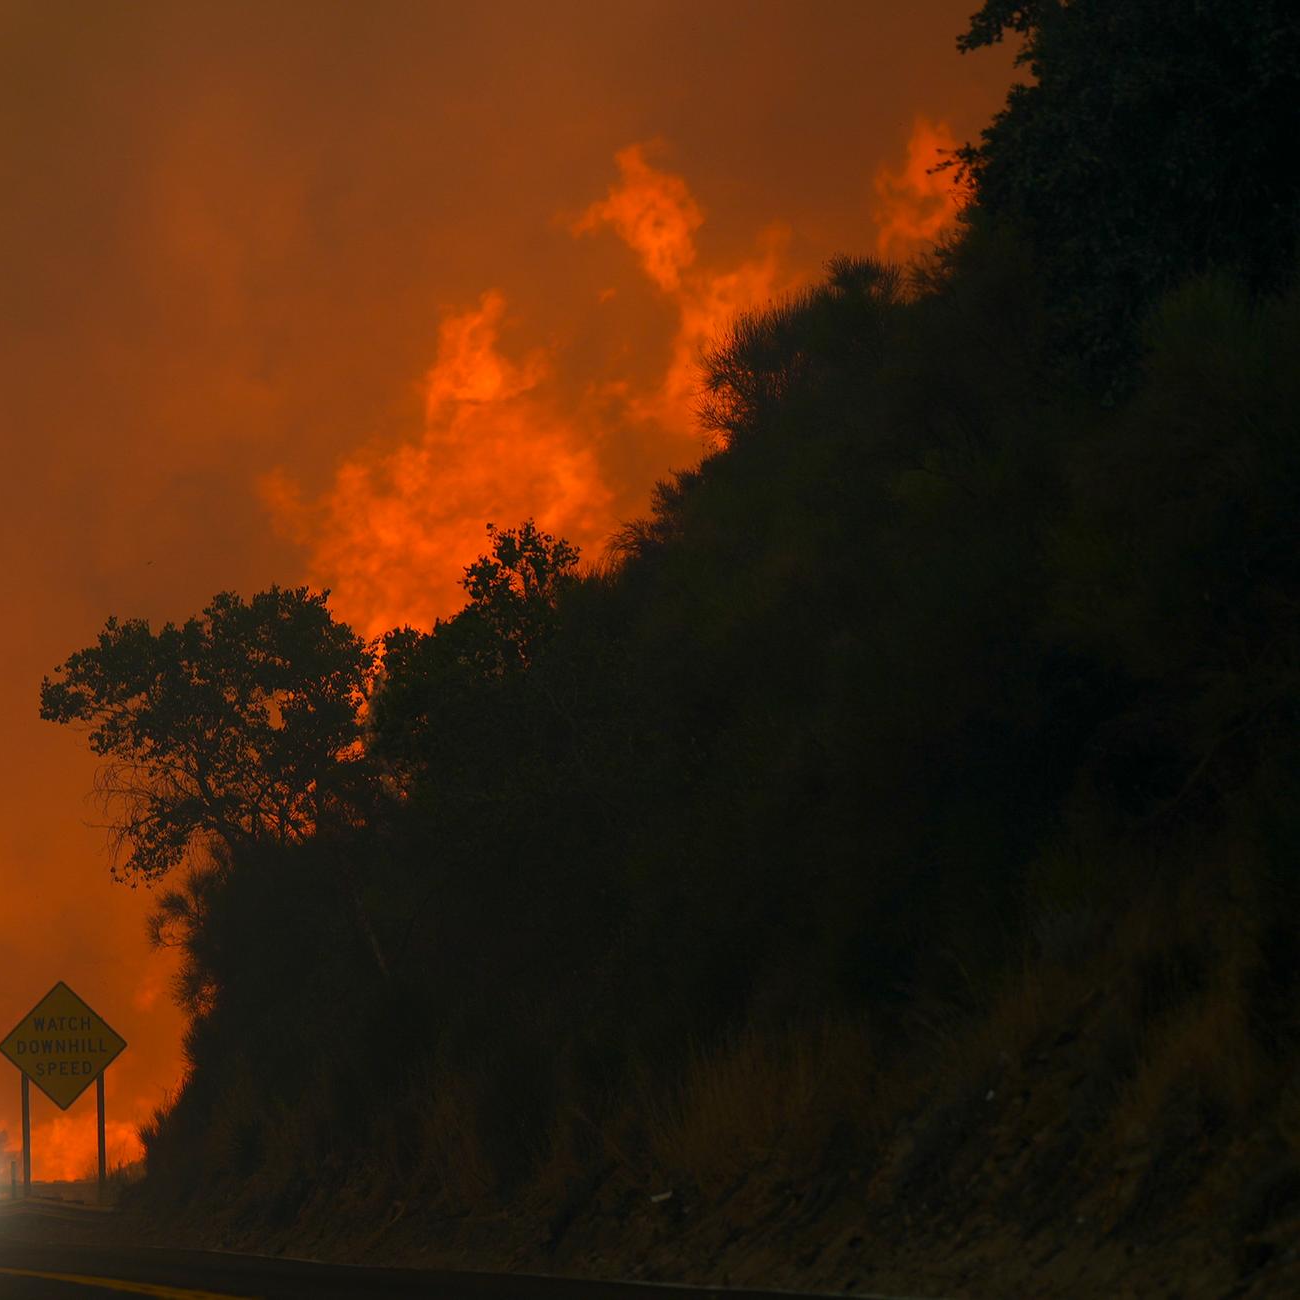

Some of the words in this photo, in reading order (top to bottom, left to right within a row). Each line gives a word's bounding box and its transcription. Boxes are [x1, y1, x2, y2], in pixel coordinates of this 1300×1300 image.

[33, 1016, 91, 1032] WATCH
[16, 1038, 108, 1055] DOWNHILL
[35, 1061, 92, 1077] SPEED
